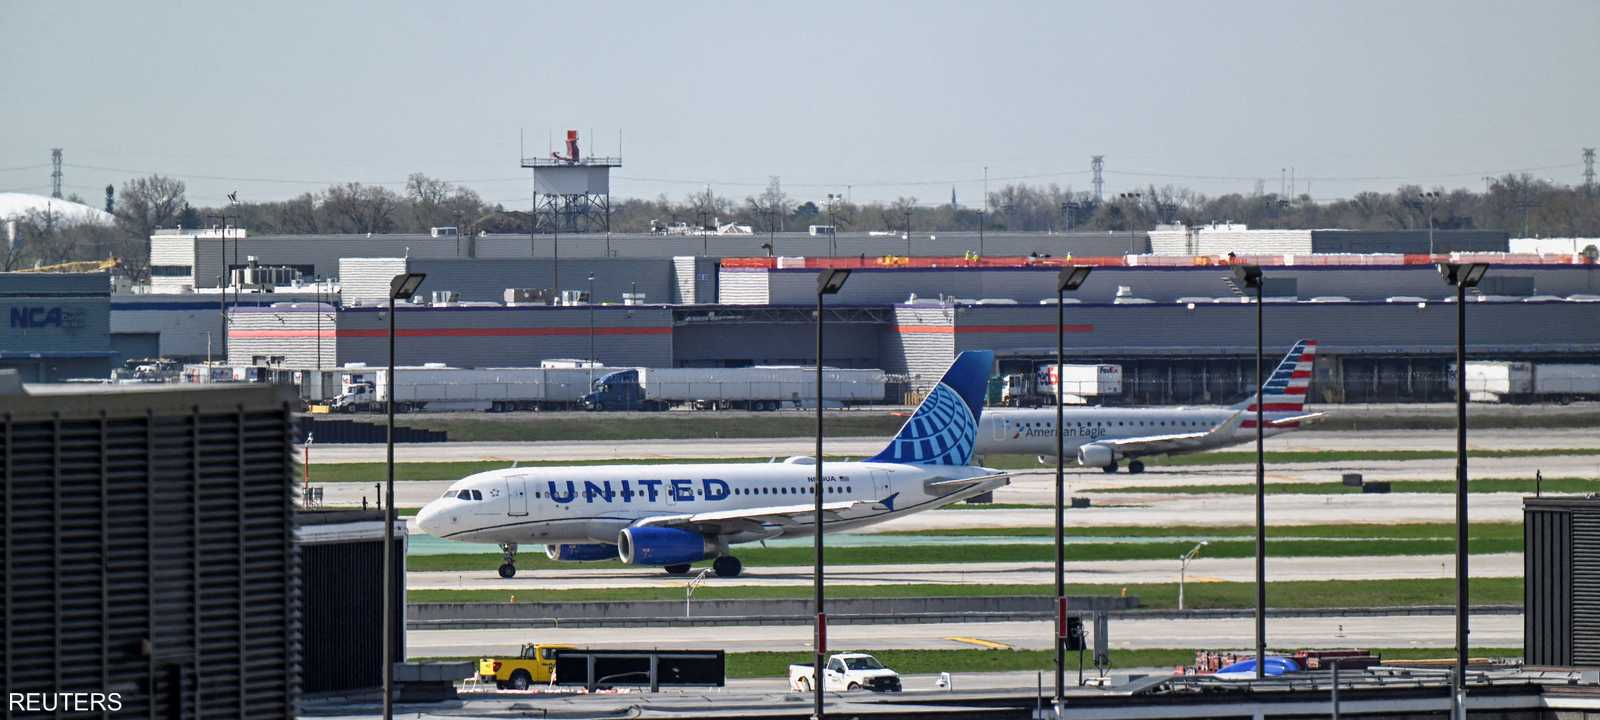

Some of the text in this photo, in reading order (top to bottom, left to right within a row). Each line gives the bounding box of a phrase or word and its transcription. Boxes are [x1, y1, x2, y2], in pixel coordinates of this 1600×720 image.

[10, 306, 62, 328] NCA
[1025, 426, 1106, 439] Ameran Eagle
[547, 478, 731, 503] UNITED
